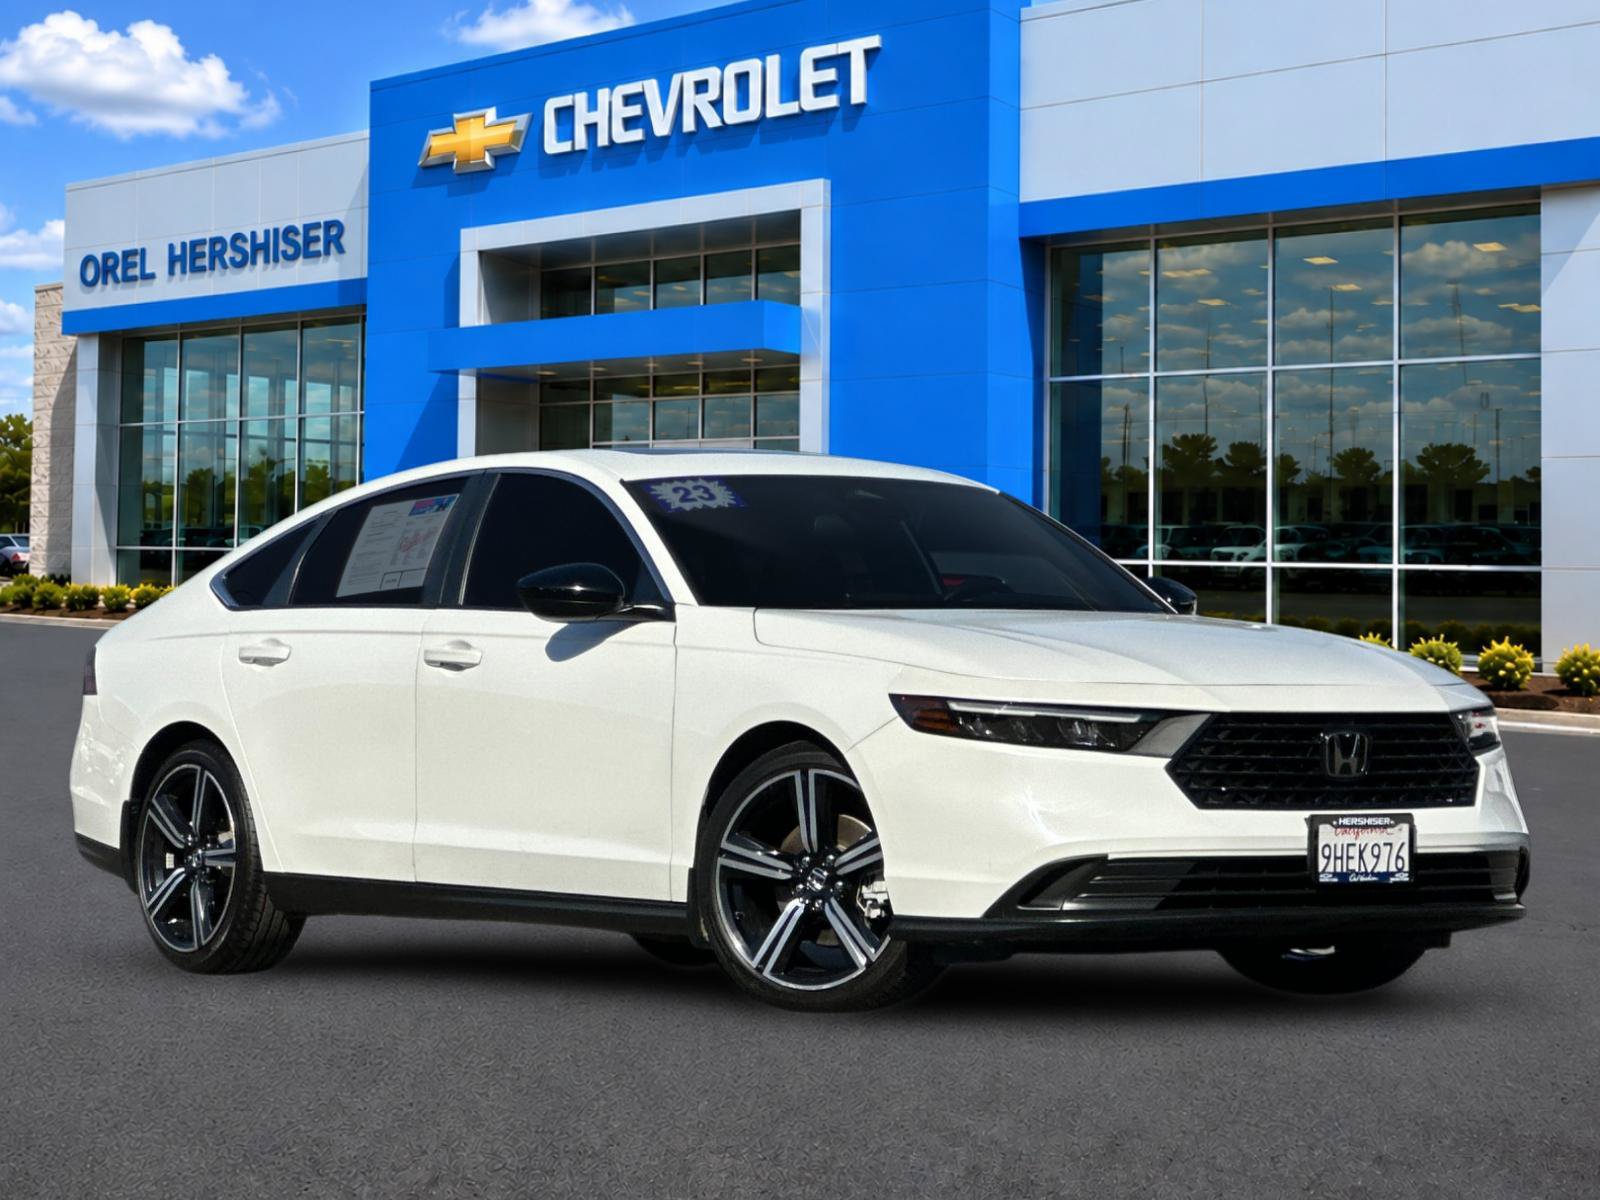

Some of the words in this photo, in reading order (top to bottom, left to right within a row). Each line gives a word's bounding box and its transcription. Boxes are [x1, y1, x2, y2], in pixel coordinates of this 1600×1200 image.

[543, 34, 882, 155] CHEVROLET
[79, 247, 156, 287] OREL
[167, 219, 346, 277] HERSHISER
[672, 485, 716, 503] 23
[1338, 817, 1391, 826] HERSHISER
[1321, 842, 1405, 873] 9HEK976
